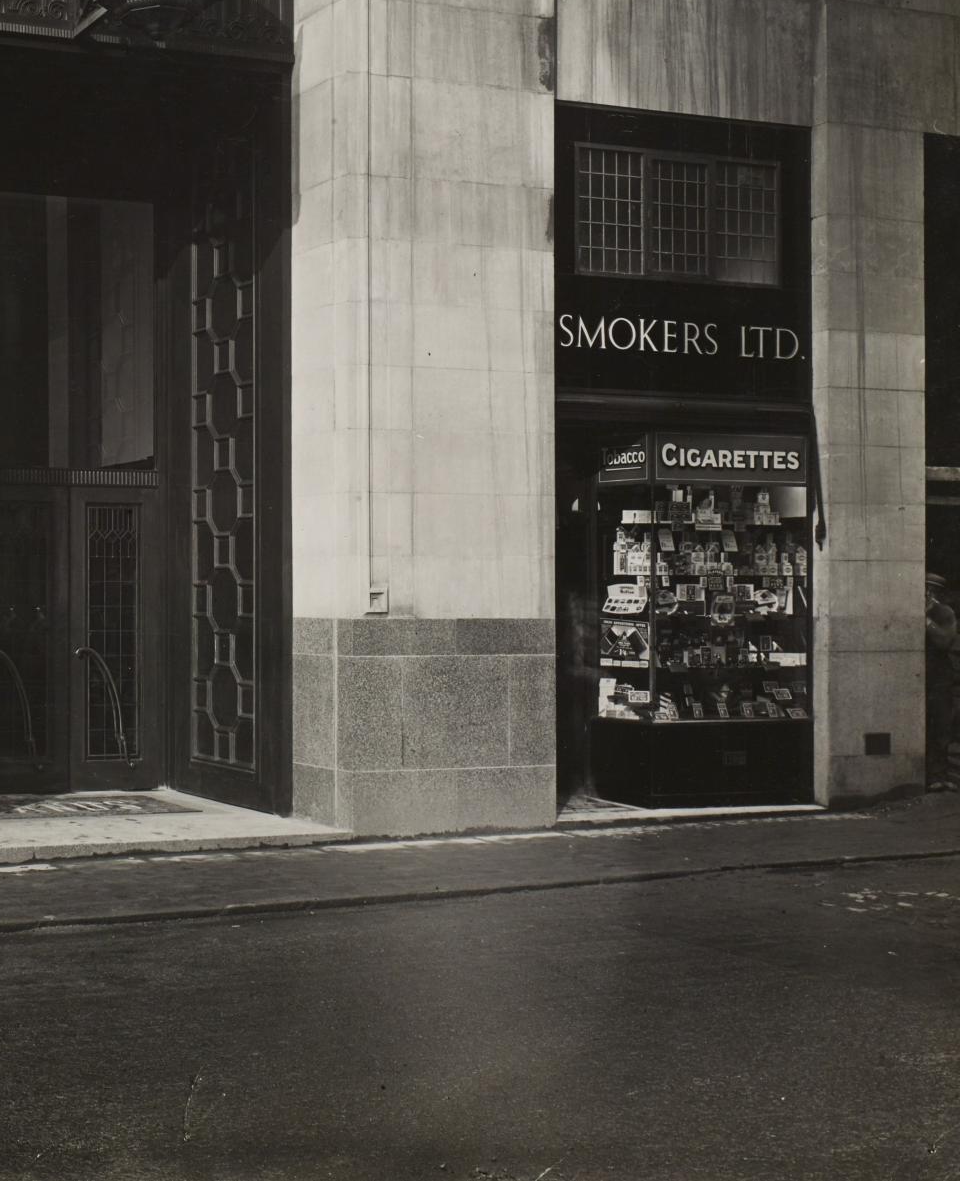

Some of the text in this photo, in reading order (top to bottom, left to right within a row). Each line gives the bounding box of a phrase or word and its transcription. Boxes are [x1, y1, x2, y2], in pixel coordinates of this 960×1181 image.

[559, 314, 806, 361] SMOKERS LTD.
[601, 442, 801, 471] Tobacco CIGARETTES
